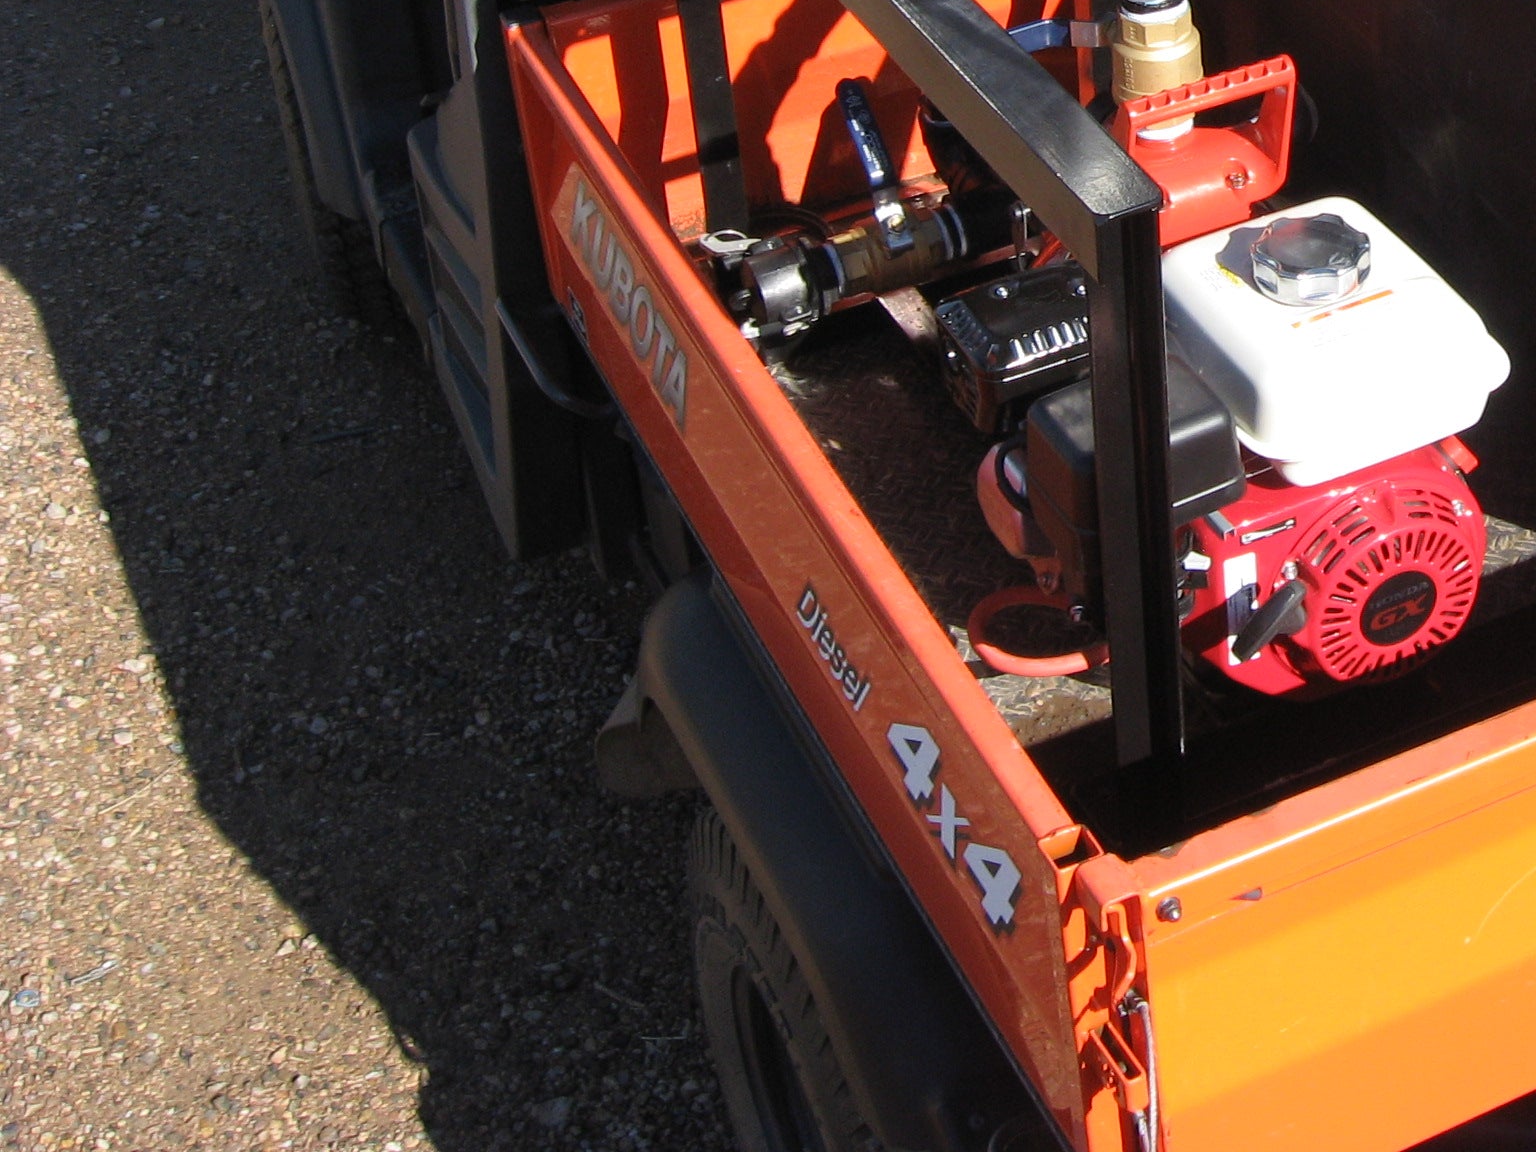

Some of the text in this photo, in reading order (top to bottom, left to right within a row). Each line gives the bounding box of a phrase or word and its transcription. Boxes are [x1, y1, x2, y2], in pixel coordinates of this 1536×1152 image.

[571, 179, 687, 432] KUBOTA
[797, 588, 871, 711] Diesel
[1371, 593, 1428, 632] GX
